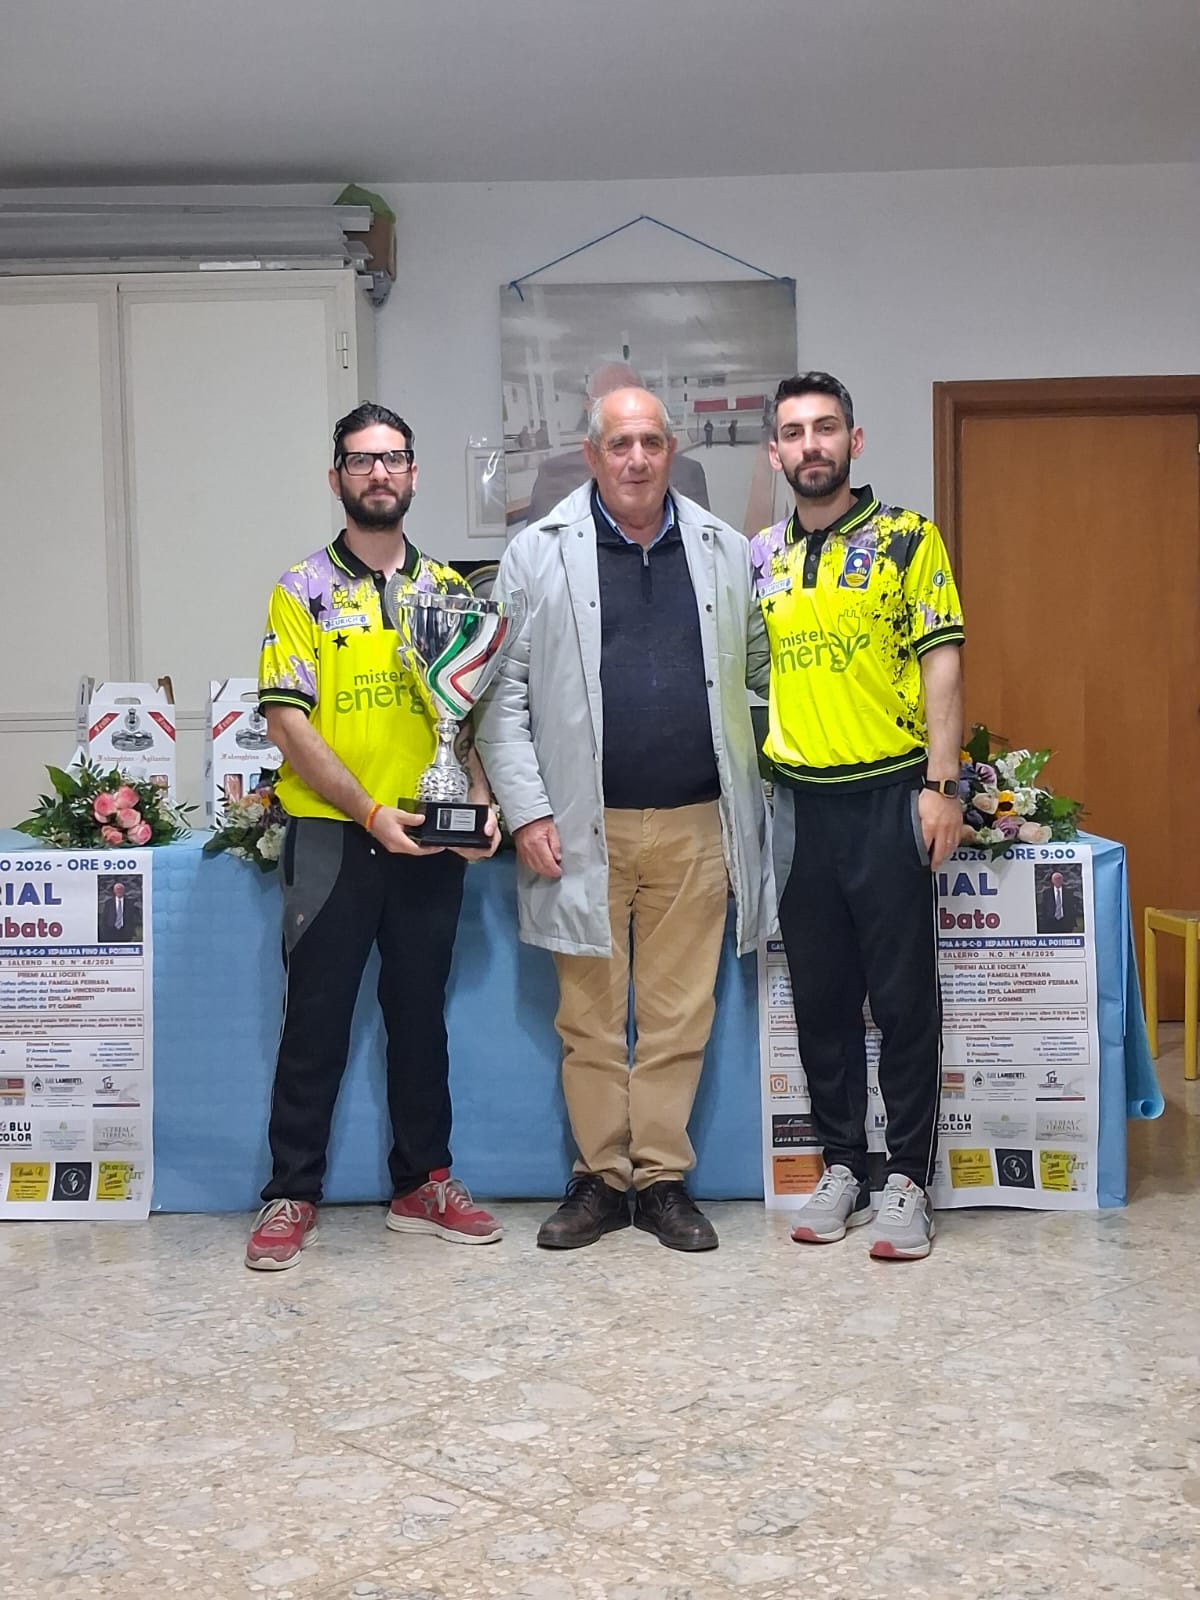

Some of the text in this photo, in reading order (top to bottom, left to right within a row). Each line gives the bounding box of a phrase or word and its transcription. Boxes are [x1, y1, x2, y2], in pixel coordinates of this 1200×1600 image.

[330, 617, 358, 627] ZURICH
[779, 629, 825, 649] mister
[354, 669, 406, 686] mister
[950, 848, 1075, 862] 2026 ORE 9:00
[16, 860, 52, 871] 2026
[67, 859, 99, 871] ORE
[104, 859, 137, 870] 9:00
[0, 882, 62, 906] IAL
[949, 1113, 971, 1122] BLU
[10, 1122, 31, 1132] BLU
